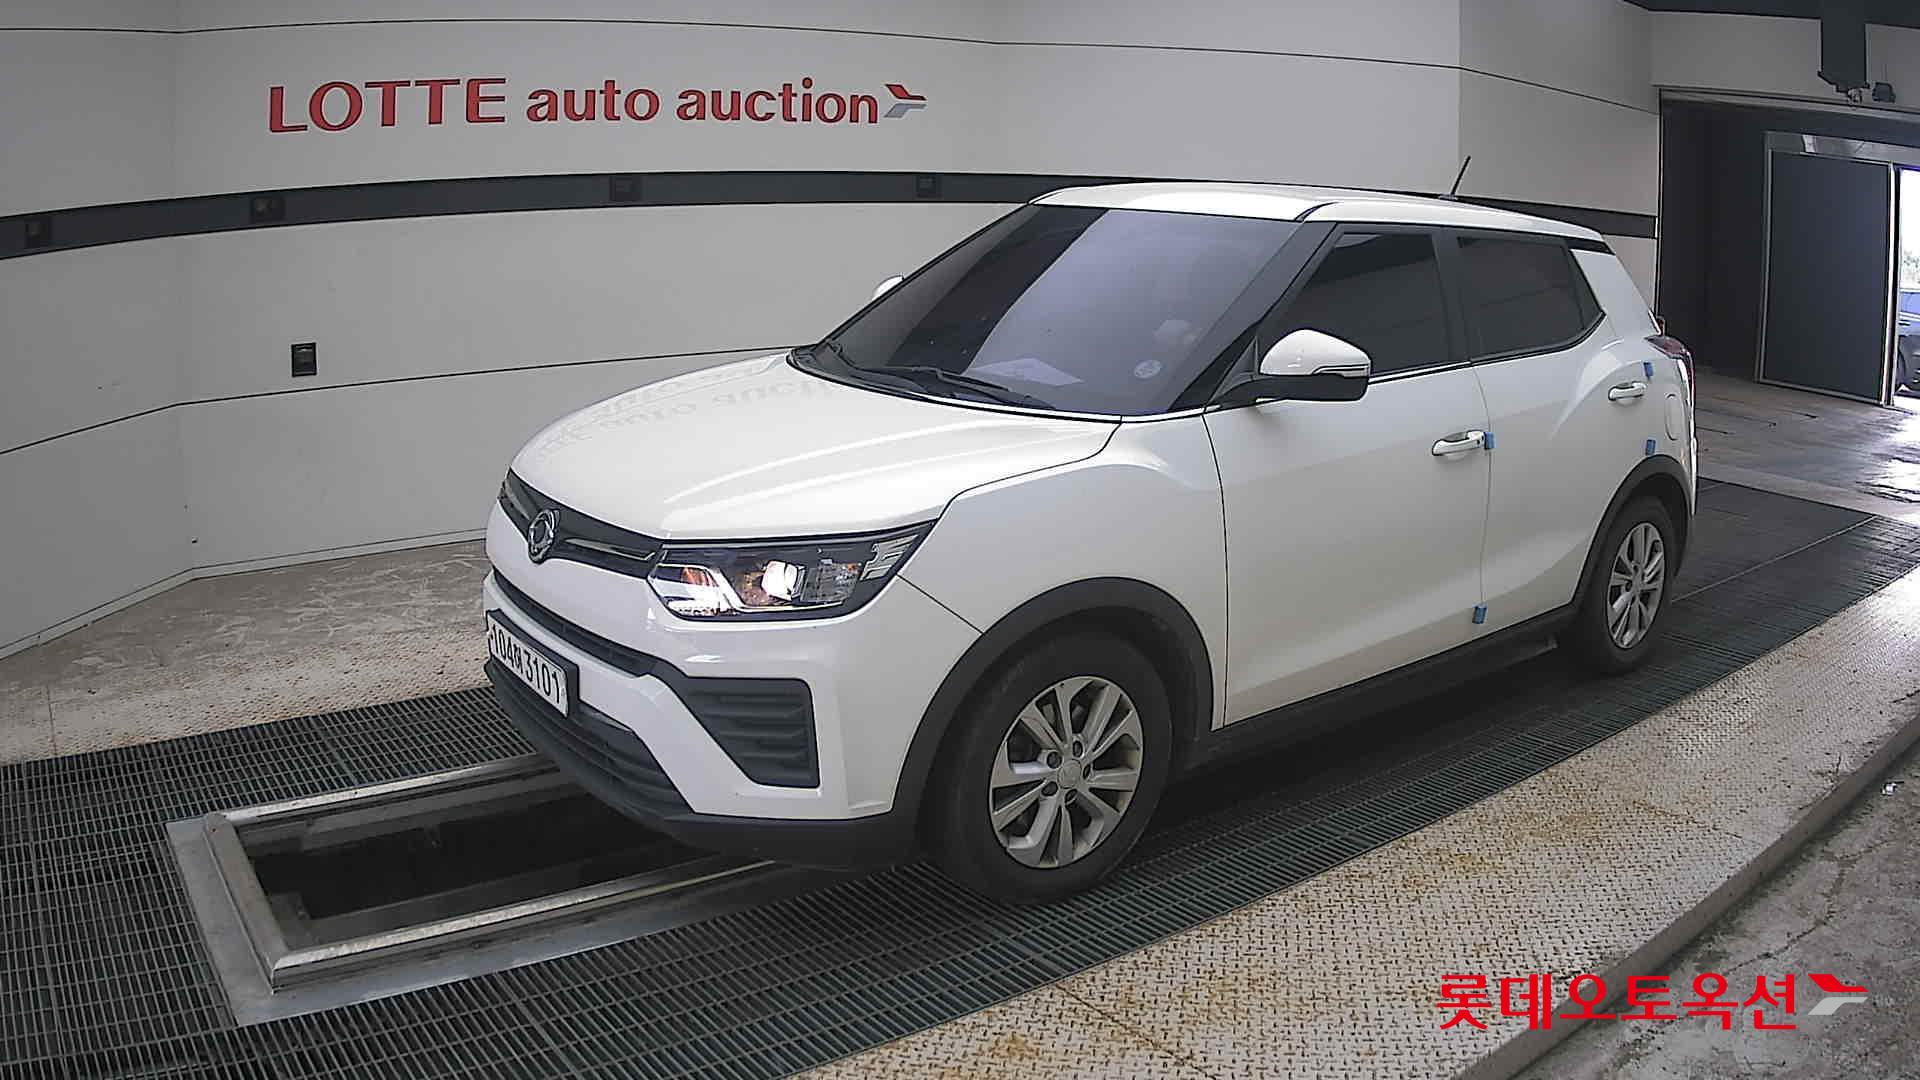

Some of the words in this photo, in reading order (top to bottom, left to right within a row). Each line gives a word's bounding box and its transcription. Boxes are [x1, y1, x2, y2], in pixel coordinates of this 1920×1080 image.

[269, 78, 506, 132] LOTTE
[526, 80, 660, 122] auto
[677, 78, 879, 124] auction
